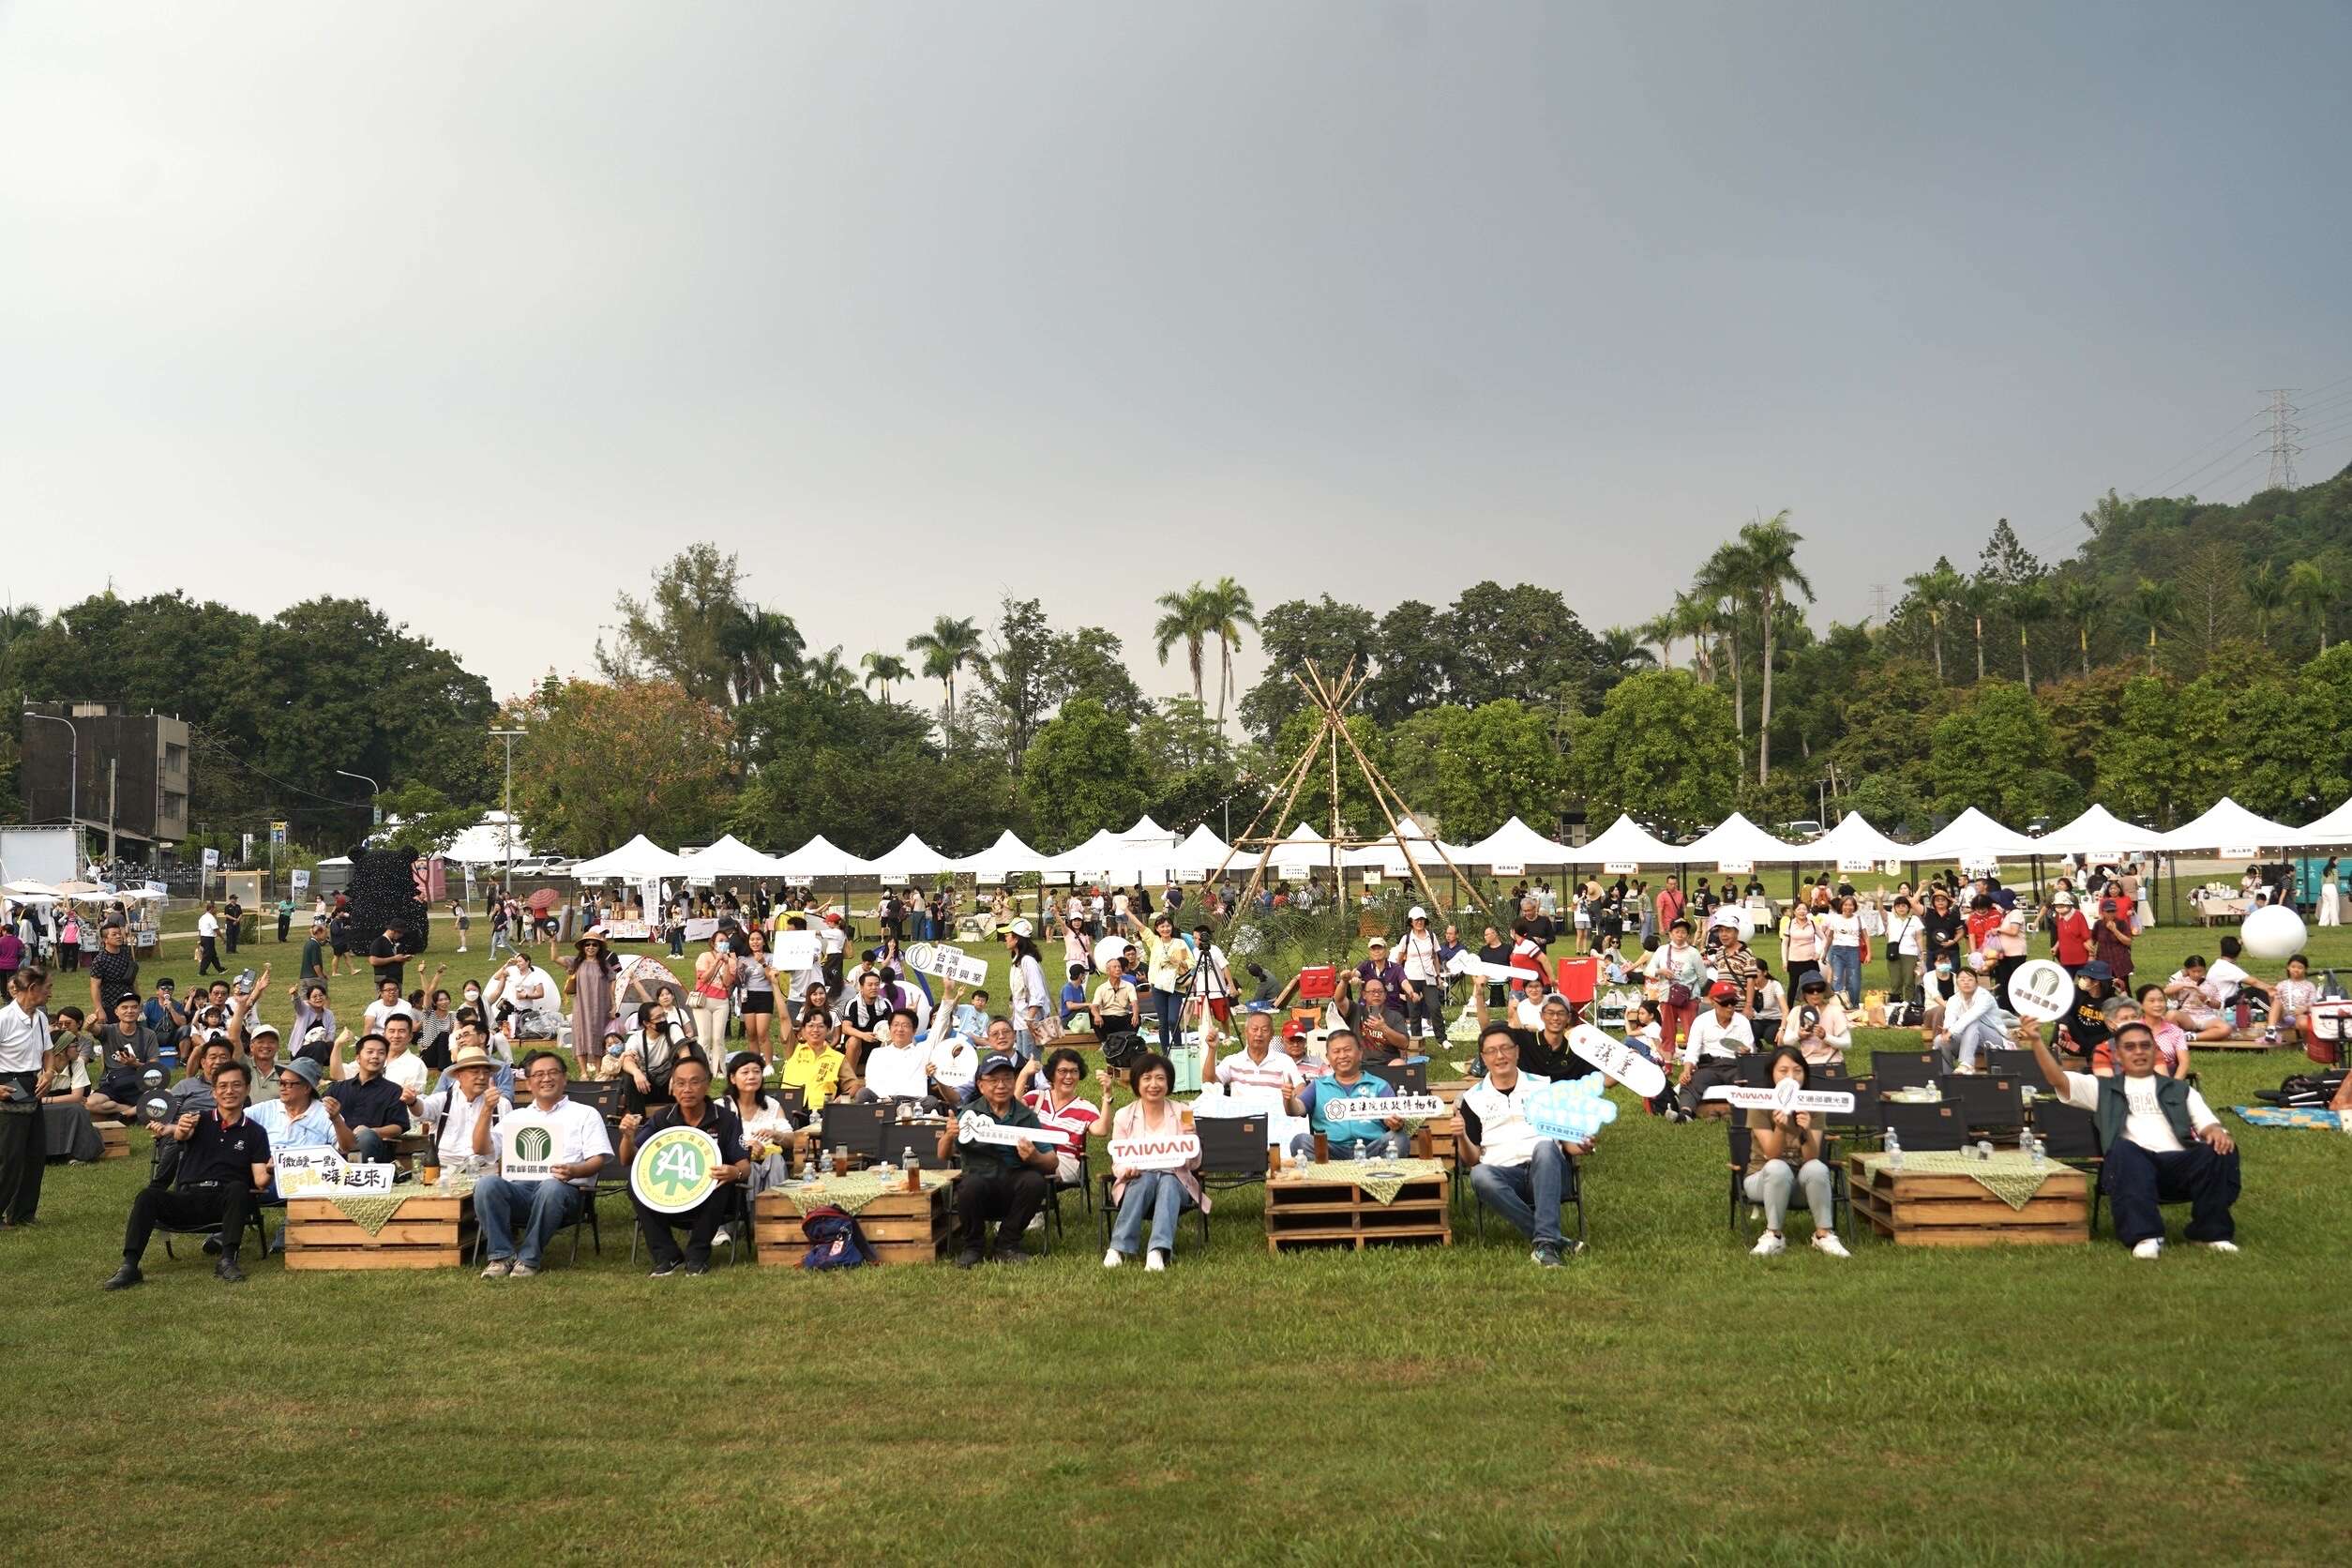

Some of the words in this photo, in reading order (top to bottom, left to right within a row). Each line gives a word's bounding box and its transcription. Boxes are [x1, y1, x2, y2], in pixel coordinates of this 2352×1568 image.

[937, 952, 960, 966] 台灣
[1730, 1092, 1773, 1100] TAIWAN
[1114, 1139, 1194, 1157] TAIWAN
